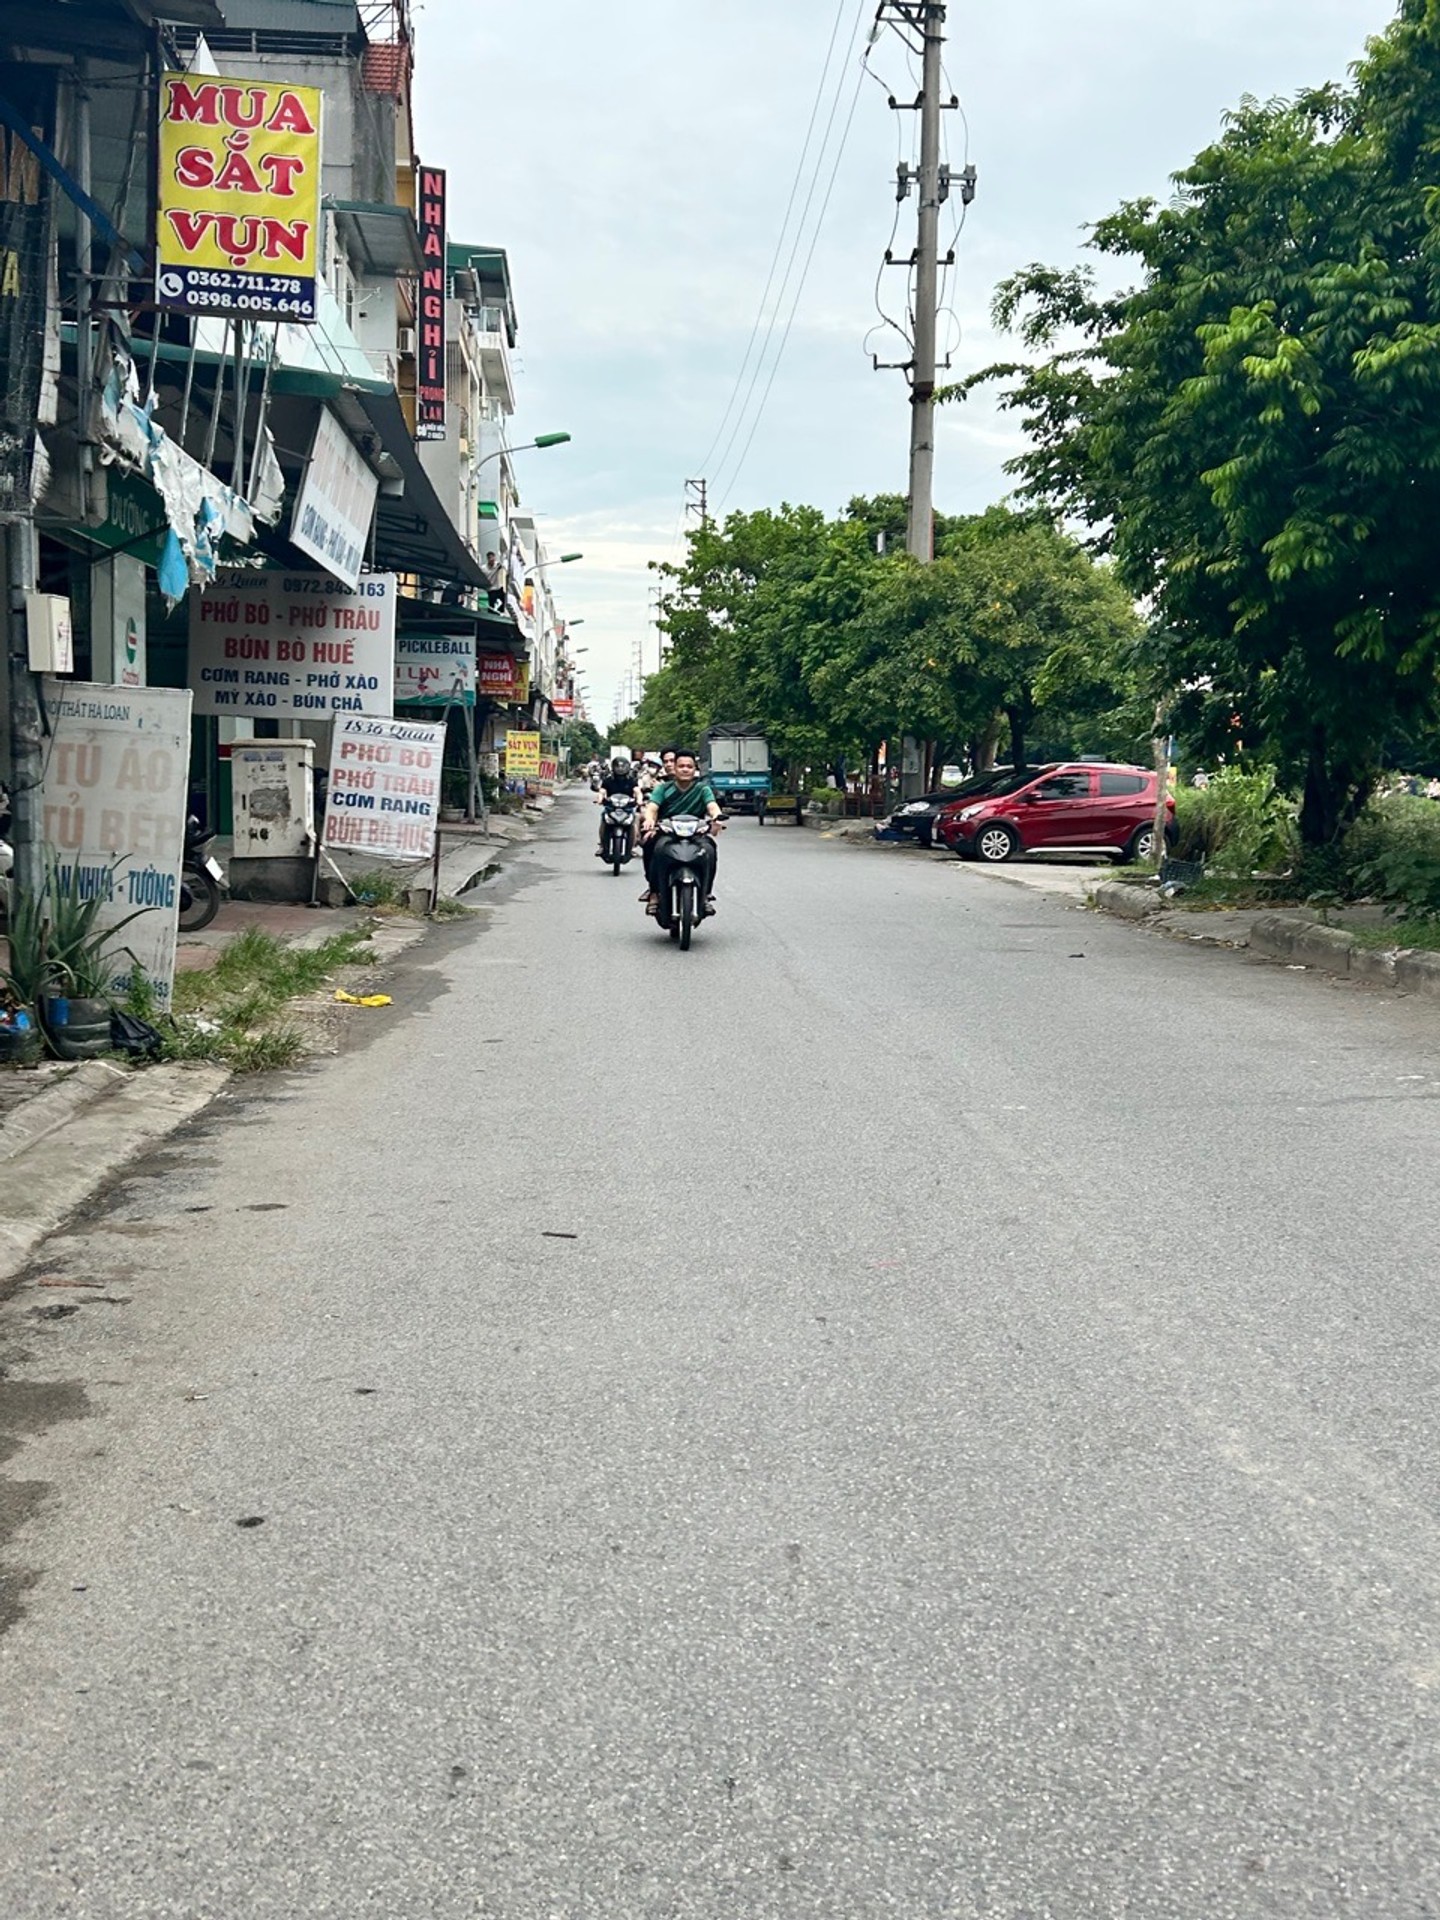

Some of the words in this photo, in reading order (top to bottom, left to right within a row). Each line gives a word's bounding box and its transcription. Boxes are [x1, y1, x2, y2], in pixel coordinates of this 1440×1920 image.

[167, 81, 315, 135] MUA
[177, 130, 304, 196] SẮT
[423, 171, 442, 256] NHÀ
[165, 209, 310, 267] VỤN
[186, 271, 301, 294] 0362.711.278
[186, 291, 313, 314] 0398.005.646
[201, 596, 239, 623] PHỞ
[245, 600, 270, 625] BÒ
[289, 601, 328, 628] PHỞ
[333, 605, 380, 631] TRÂU
[224, 634, 270, 660] BÚN
[276, 637, 306, 662] BÒ
[313, 637, 357, 664] HUẾ
[399, 640, 472, 655] PICKLEBALL
[201, 667, 239, 683] CƠM
[245, 670, 290, 686] RANG
[307, 671, 341, 688] PHỞ
[345, 673, 379, 690] XÀO
[103, 704, 131, 720] LOAN
[245, 690, 277, 707] XÀO
[293, 692, 326, 709] BÚN
[331, 693, 363, 711] CHẢ
[344, 720, 383, 735] 1836
[400, 747, 432, 769] BÒ
[332, 766, 376, 789] PHỞ
[332, 792, 375, 809] CƠM
[381, 797, 432, 816] RANG
[326, 811, 362, 844] BÚN
[128, 863, 176, 908] TƯỜNG
